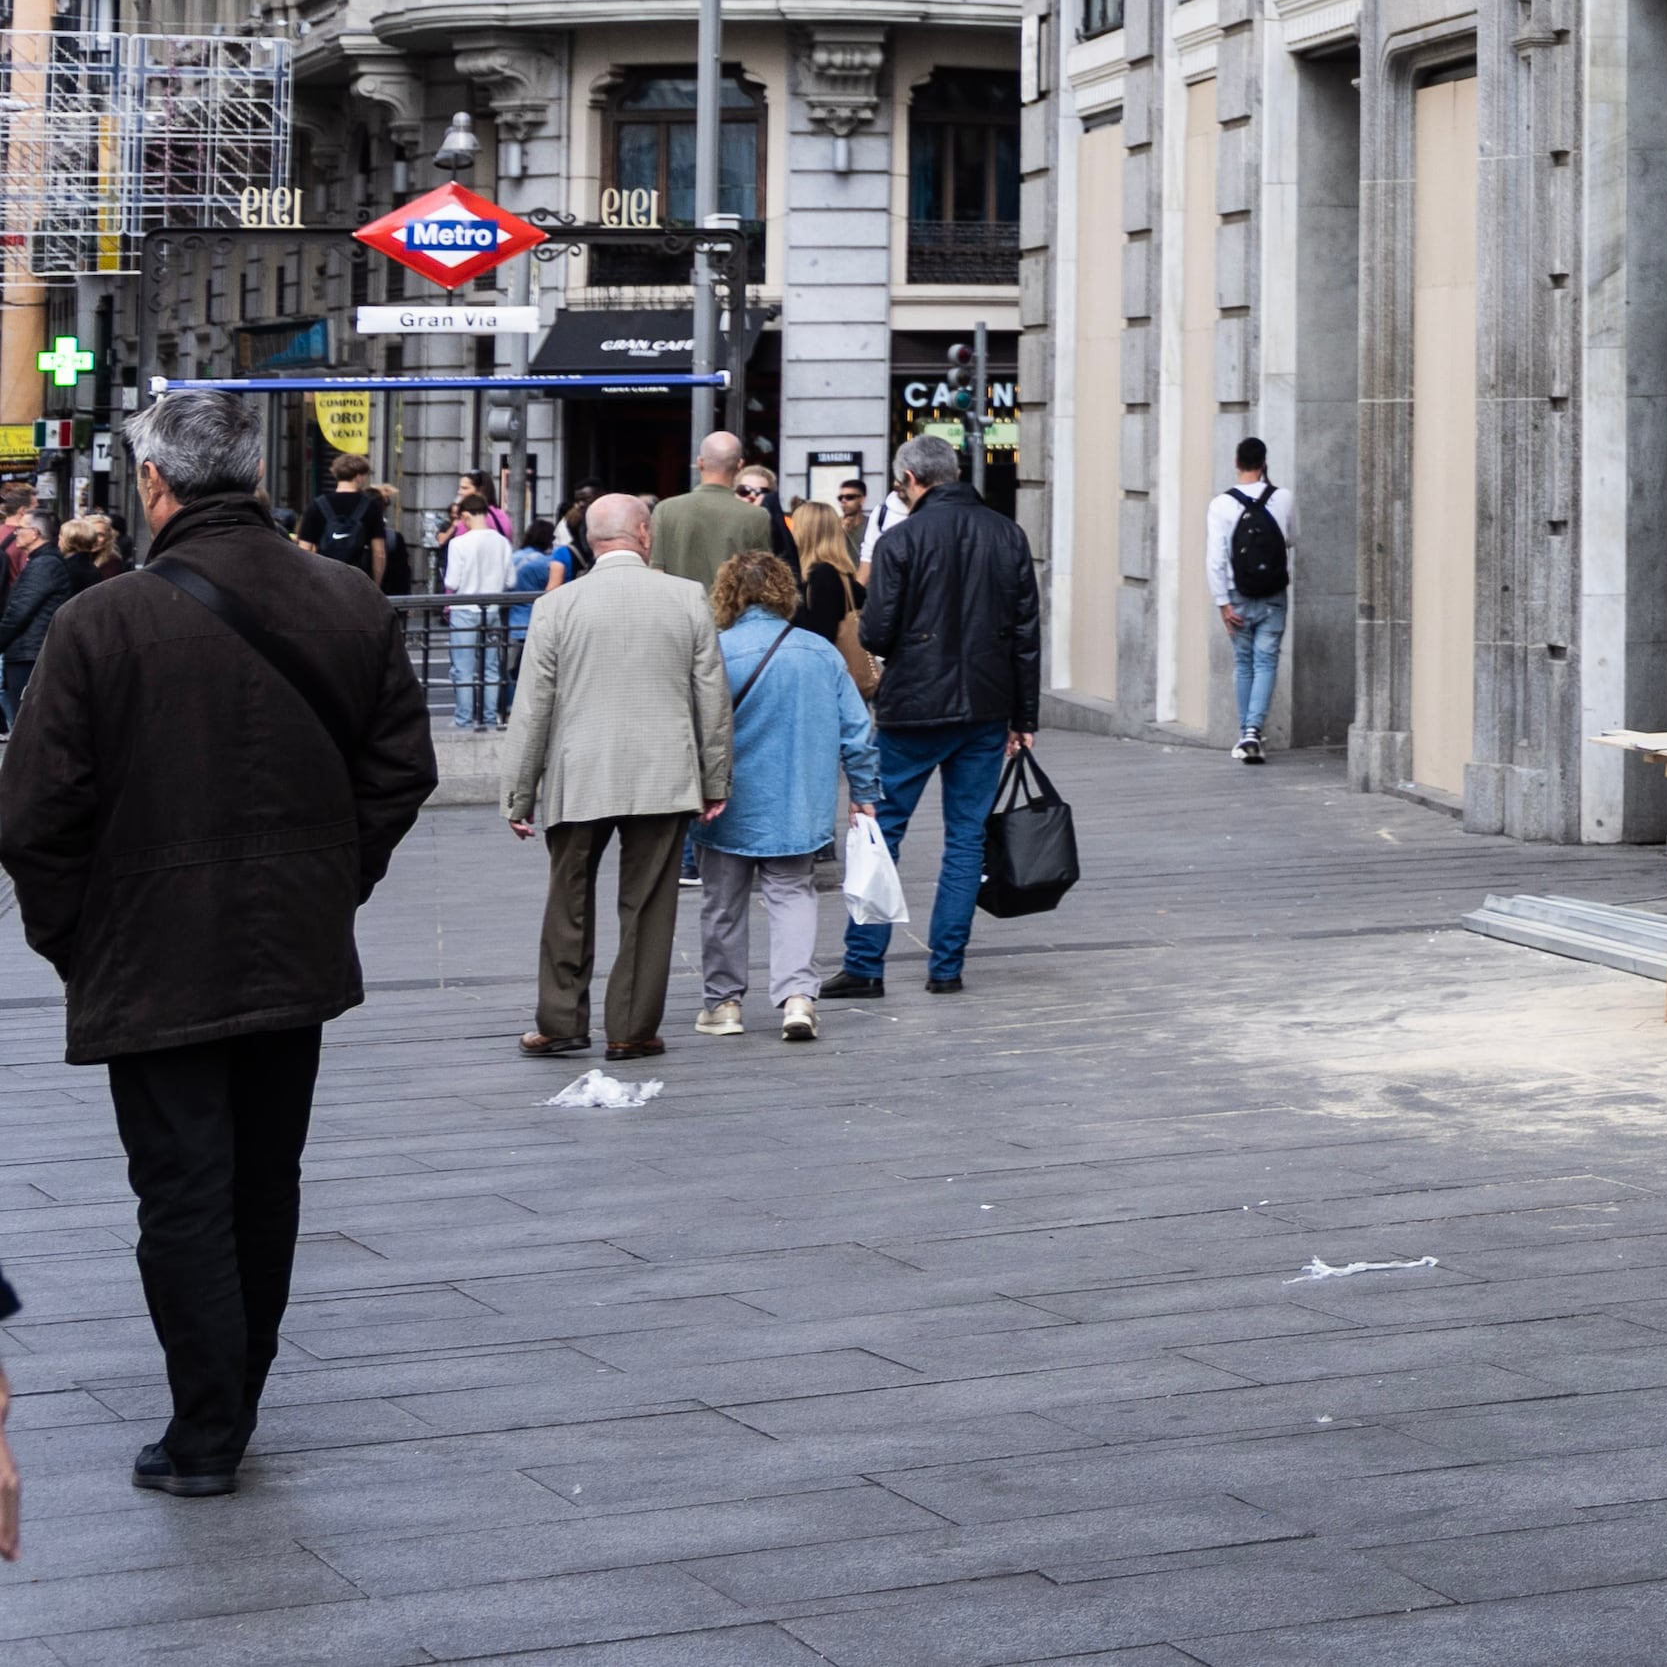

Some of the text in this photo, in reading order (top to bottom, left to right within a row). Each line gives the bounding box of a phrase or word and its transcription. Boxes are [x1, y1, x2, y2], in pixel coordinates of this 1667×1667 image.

[413, 223, 493, 246] Metro
[400, 312, 454, 327] Gran
[600, 339, 650, 351] GRAN
[330, 411, 364, 425] ORO
